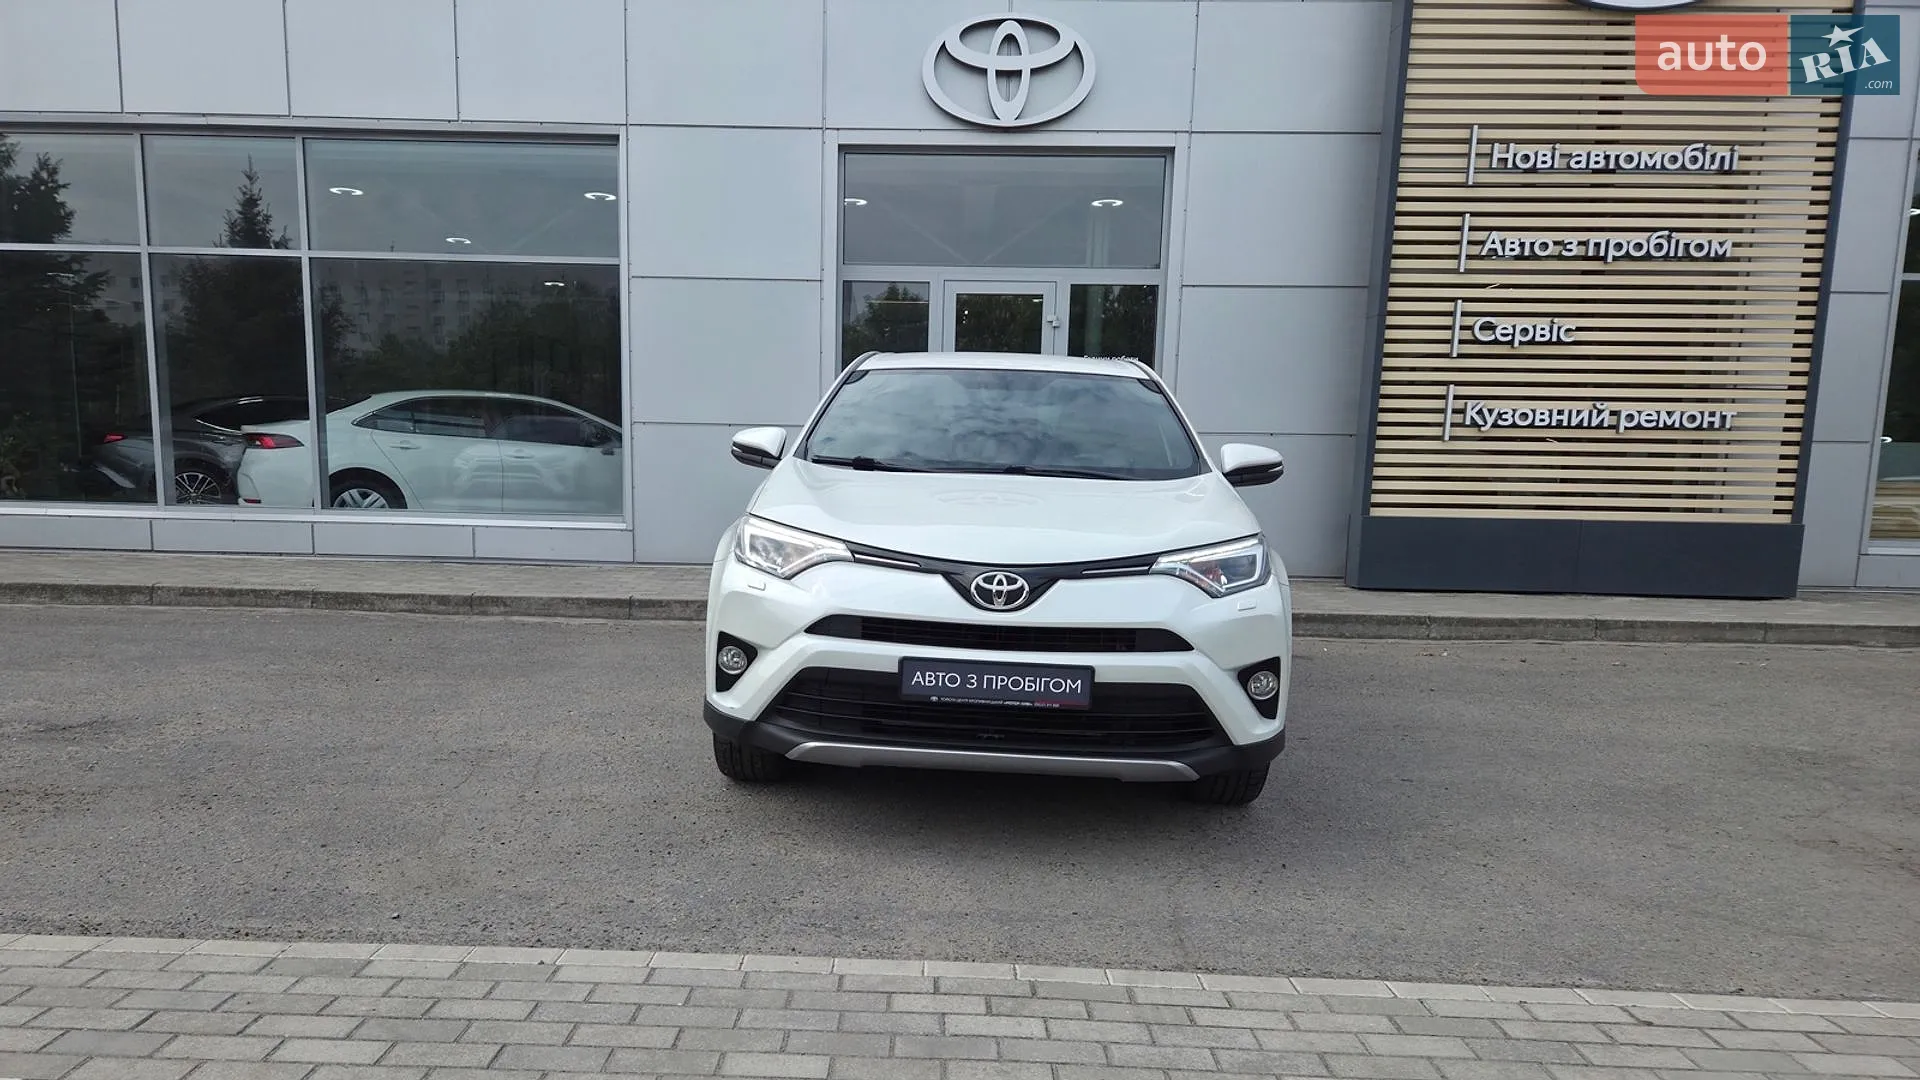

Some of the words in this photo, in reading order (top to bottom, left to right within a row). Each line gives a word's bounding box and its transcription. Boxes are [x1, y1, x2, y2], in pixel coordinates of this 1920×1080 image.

[1491, 143, 1561, 169] Нові
[1569, 143, 1740, 170] автомобілі
[1481, 231, 1554, 257] Авто
[1562, 236, 1578, 257] з
[1587, 231, 1733, 263] пробігом
[1473, 317, 1577, 348] Сервіс
[1464, 401, 1610, 431] Кузовний
[1618, 408, 1737, 433] ремонт
[911, 671, 960, 688] АВТО
[966, 674, 978, 689] З
[983, 675, 1082, 694] ПРОБІГОМ
